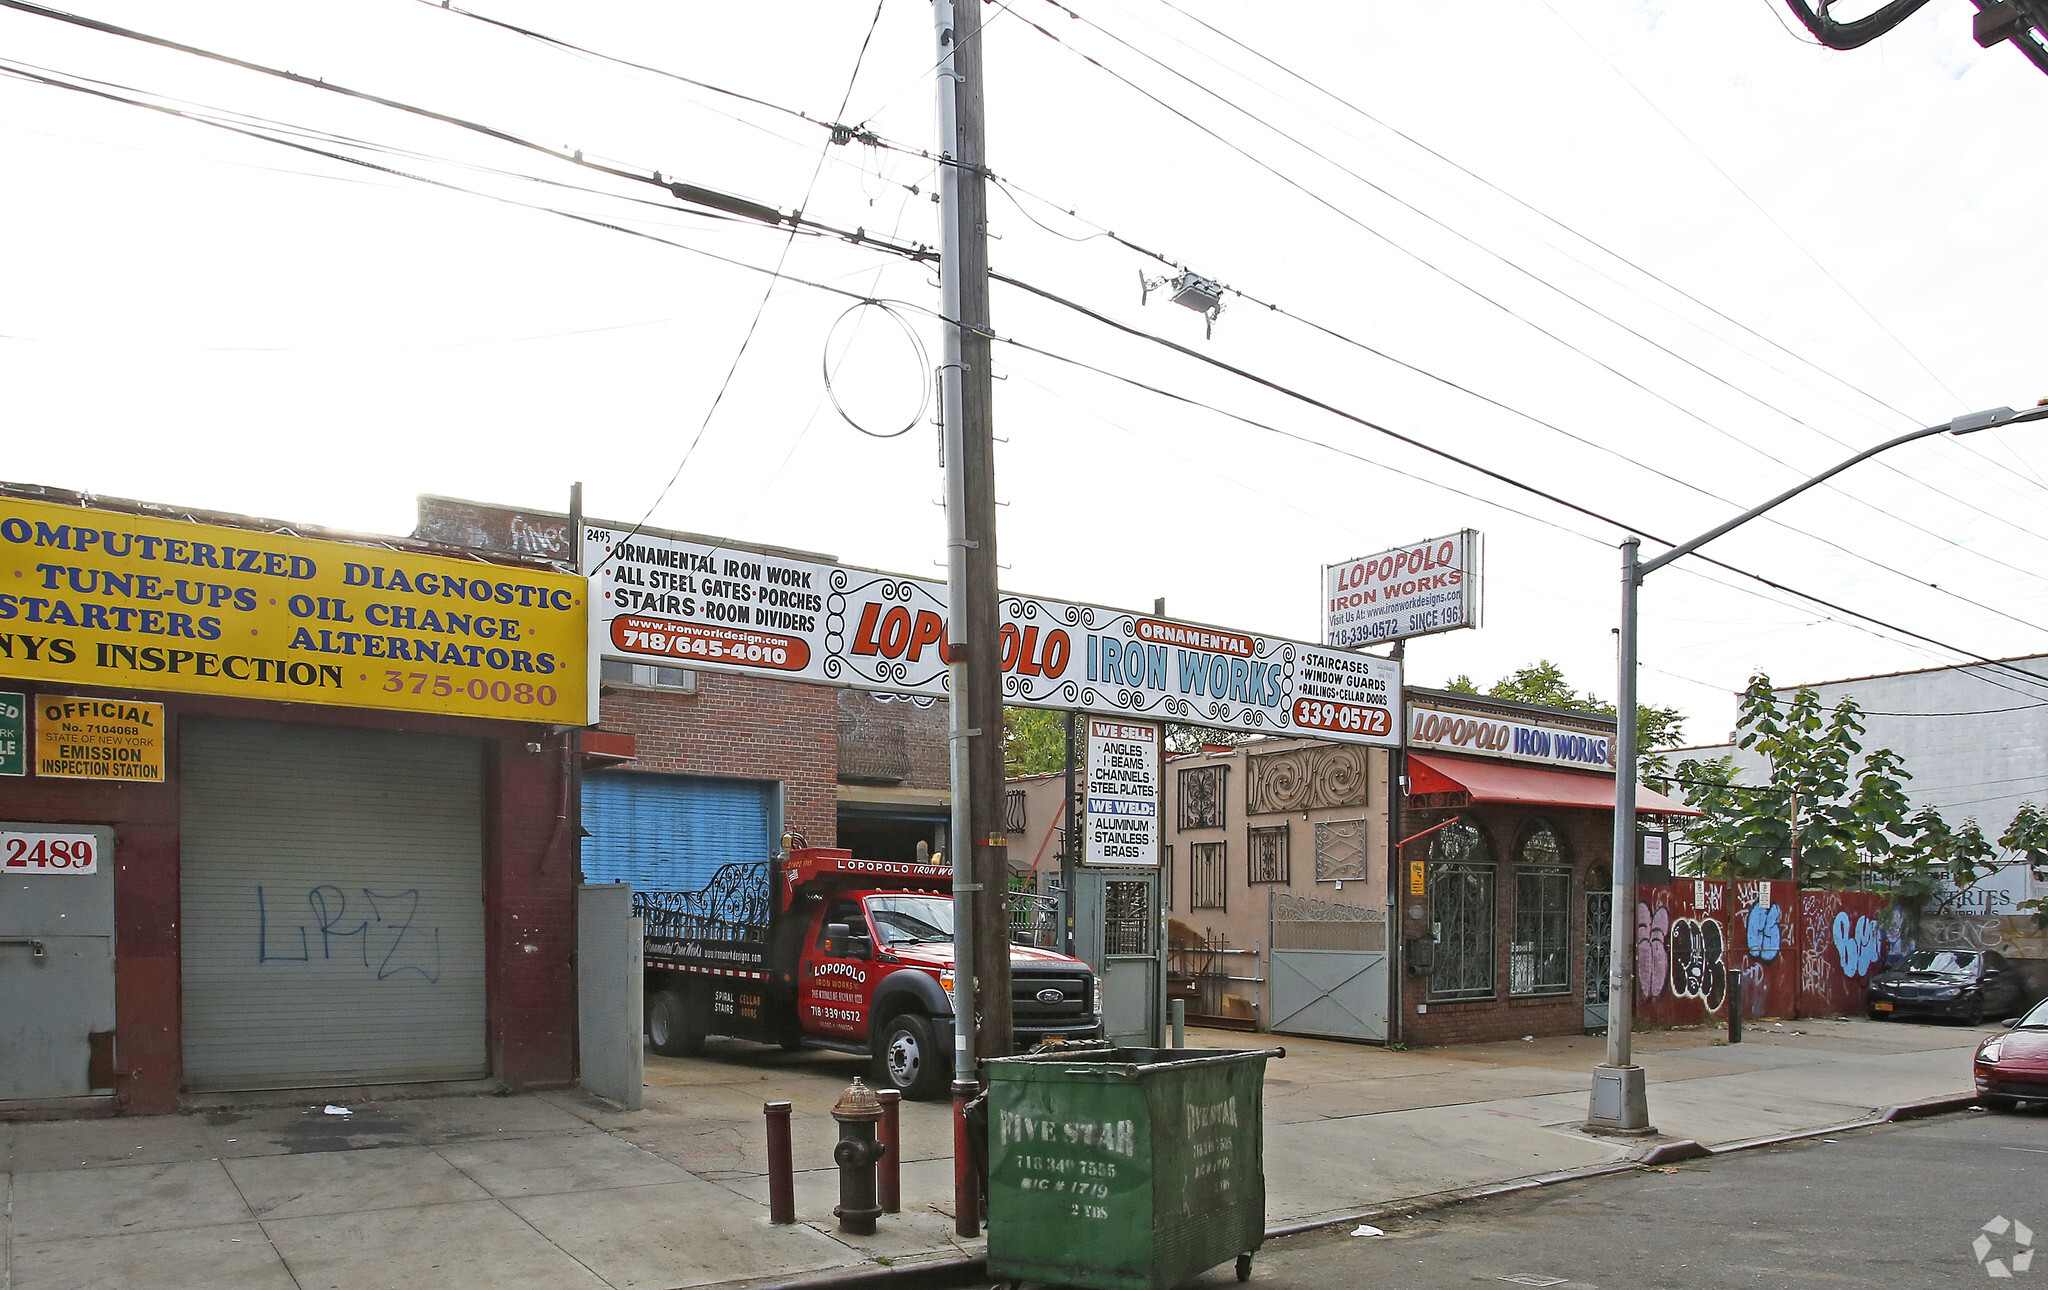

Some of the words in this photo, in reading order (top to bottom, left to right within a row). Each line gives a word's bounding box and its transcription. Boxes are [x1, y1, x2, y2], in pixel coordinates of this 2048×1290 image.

[587, 529, 611, 543] 2495
[615, 542, 717, 574] ORNAMENTAL
[724, 559, 761, 581] IRON
[767, 566, 812, 588] WORK
[1338, 540, 1454, 592] LOPOPOLO
[343, 562, 572, 611] DIAGNOSTIC
[614, 566, 644, 586] ALL
[649, 570, 697, 594] STEEL
[702, 579, 751, 601] GATES
[759, 587, 822, 613] PORCHES
[1330, 589, 1377, 612] IRON
[1384, 570, 1462, 600] WORKS
[36, 563, 257, 612] TUNE-UPS
[288, 594, 354, 623] OIL
[365, 604, 521, 641] CHANGE
[614, 587, 695, 616] STAIRS
[706, 600, 750, 624] ROOM
[756, 608, 815, 633] DIVIDERS
[1329, 609, 1345, 627] Visit
[1345, 611, 1355, 623] Us
[1409, 610, 1438, 631] SINCE
[0, 594, 222, 641] STARTERS
[289, 627, 556, 674] ALTERNATORS
[628, 619, 788, 647] www.ironworkdesign.com
[850, 601, 1071, 680] LOPOLO
[1140, 621, 1250, 655] ORNAMENTAL
[623, 629, 788, 665] 718/645-4010
[96, 642, 343, 688] INSPECTION
[382, 670, 558, 707] 375-0080
[1086, 633, 1169, 692] IRON
[1178, 648, 1283, 709] WORKS
[1306, 653, 1369, 675] STAIRCASES
[1304, 668, 1344, 685] WINDOW
[1346, 675, 1386, 692] GUARDS
[1302, 683, 1336, 699] RAILINGS
[1339, 688, 1365, 703] CELLAR
[1366, 692, 1388, 706] DOORS
[45, 702, 154, 727] OFFICIAL
[45, 733, 78, 743] STATE
[81, 735, 95, 744] OF
[99, 736, 123, 745] NEW
[125, 737, 154, 747] YORK
[62, 723, 83, 733] No.
[86, 724, 139, 736] 7104068
[1094, 723, 1118, 738] WE
[1120, 726, 1154, 742] SELL:
[1413, 712, 1510, 751] LOPOPOLO
[1513, 727, 1551, 757] IRON
[1555, 734, 1607, 765] WORKS
[60, 744, 142, 762] EMISSION
[1103, 742, 1143, 757] ANGLES
[42, 759, 109, 776] INSPECTION
[113, 763, 158, 778] STATION
[1095, 768, 1150, 783] CHANNELS
[1090, 781, 1119, 795] STEEL
[1120, 783, 1154, 797] PLATES
[1091, 799, 1113, 813] WE
[1114, 801, 1155, 816] WELD:
[1095, 818, 1149, 832] ALUMINUM
[1094, 832, 1149, 845] STAINLESS
[6, 839, 93, 869] 2489
[1103, 845, 1139, 858] BRASS
[837, 860, 909, 874] LOPOPOLO
[913, 865, 935, 875] IRON
[814, 963, 866, 983] LOPOPOLO
[816, 979, 831, 987] IRON
[832, 980, 853, 990] WORKS
[715, 991, 734, 1002] SPIRAL
[740, 994, 761, 1006] CELLAR
[715, 1003, 734, 1014] STAIRS
[1000, 1108, 1056, 1146] FIVE
[1063, 1119, 1135, 1157] STAR
[1017, 1155, 1043, 1170] 718
[1080, 1160, 1117, 1178] 7555
[1071, 1203, 1080, 1216] 2
